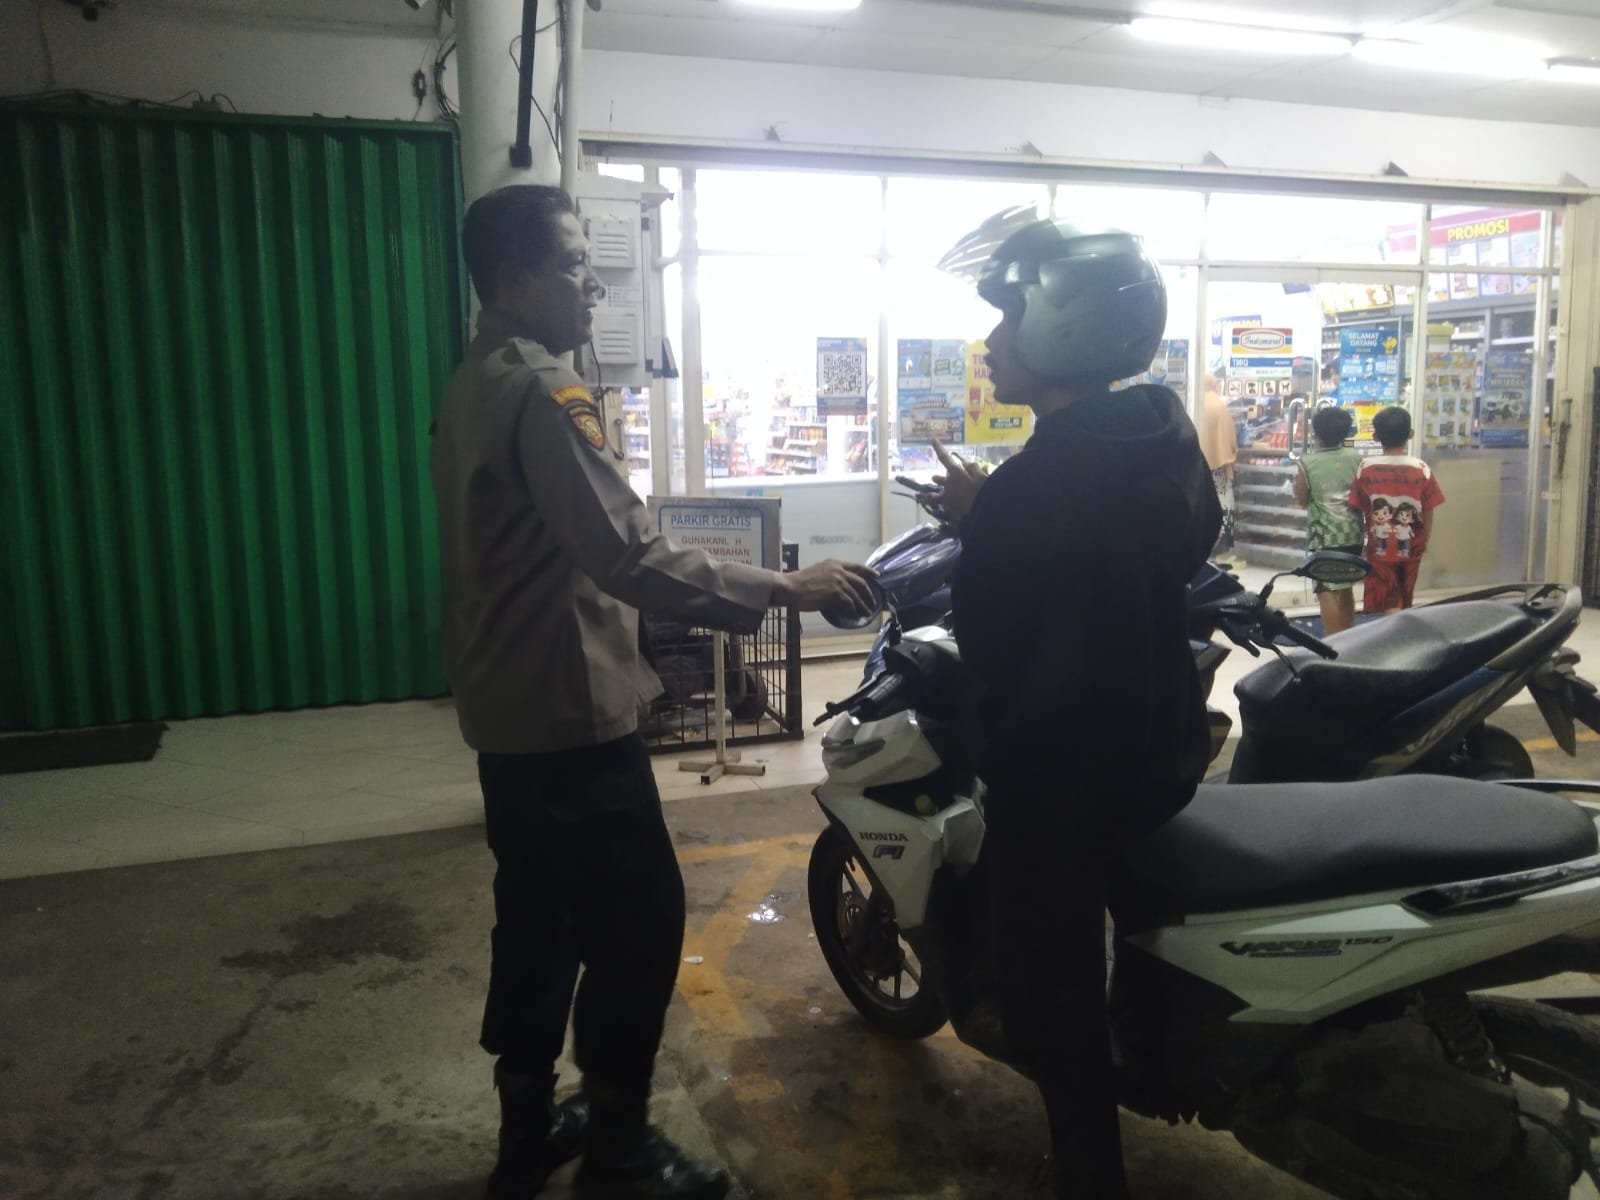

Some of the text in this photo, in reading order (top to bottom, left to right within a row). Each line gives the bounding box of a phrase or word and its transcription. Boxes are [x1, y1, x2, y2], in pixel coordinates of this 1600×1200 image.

[1447, 218, 1510, 242] PROMOSI
[671, 515, 752, 527] PARKIR GRATIS
[859, 832, 909, 842] HONDA
[1345, 936, 1394, 945] 150
